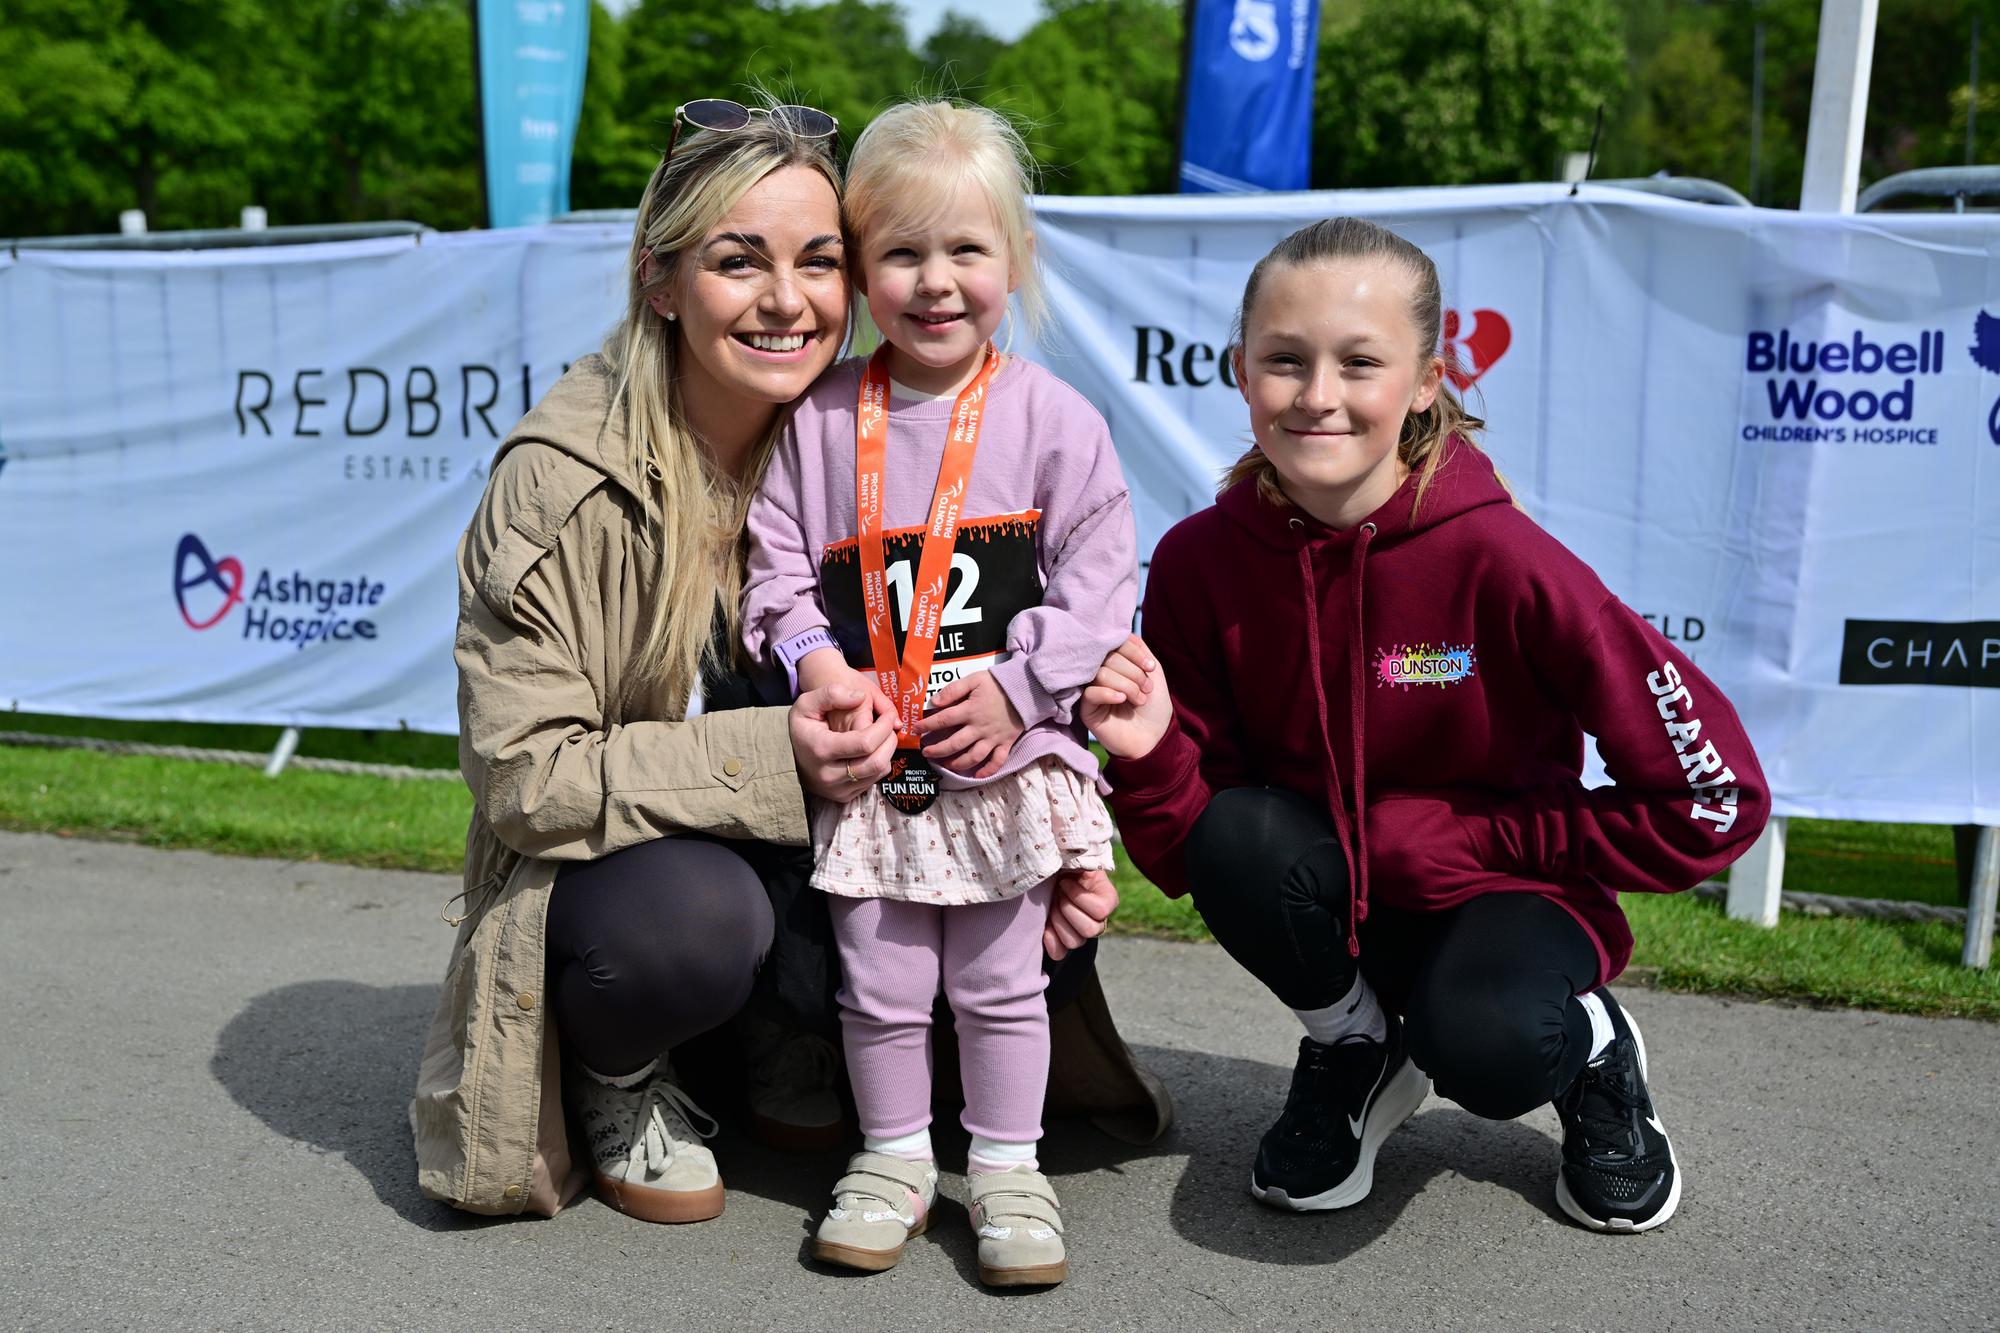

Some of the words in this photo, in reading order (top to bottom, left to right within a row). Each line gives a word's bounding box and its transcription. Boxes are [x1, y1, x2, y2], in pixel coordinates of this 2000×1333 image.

[1747, 329, 1944, 374] Bluebell
[235, 363, 569, 438] REDBRI
[1767, 378, 1914, 422] Wood
[954, 403, 970, 442] PRONTO
[964, 409, 979, 444] PAINTS
[1742, 425, 1847, 443] CHILDREN'S
[1854, 428, 1938, 444] HOSPICE
[344, 456, 450, 481] ESTATE
[861, 474, 869, 509] PAINTS
[870, 472, 879, 513] PRONTO
[932, 496, 949, 537] PRONTO
[943, 504, 959, 539] PAINTS
[252, 568, 385, 614] Ashgate
[865, 572, 875, 608] PAINTS
[873, 570, 885, 615] PRONTO
[885, 552, 983, 632] 12
[243, 606, 377, 650] Hospice
[914, 595, 929, 638] PRONTO
[924, 603, 939, 639] PAINTS
[934, 632, 965, 654] LIE
[1390, 657, 1462, 675] DUNSTON
[882, 782, 907, 795] FUN
[909, 783, 935, 795] RUN
